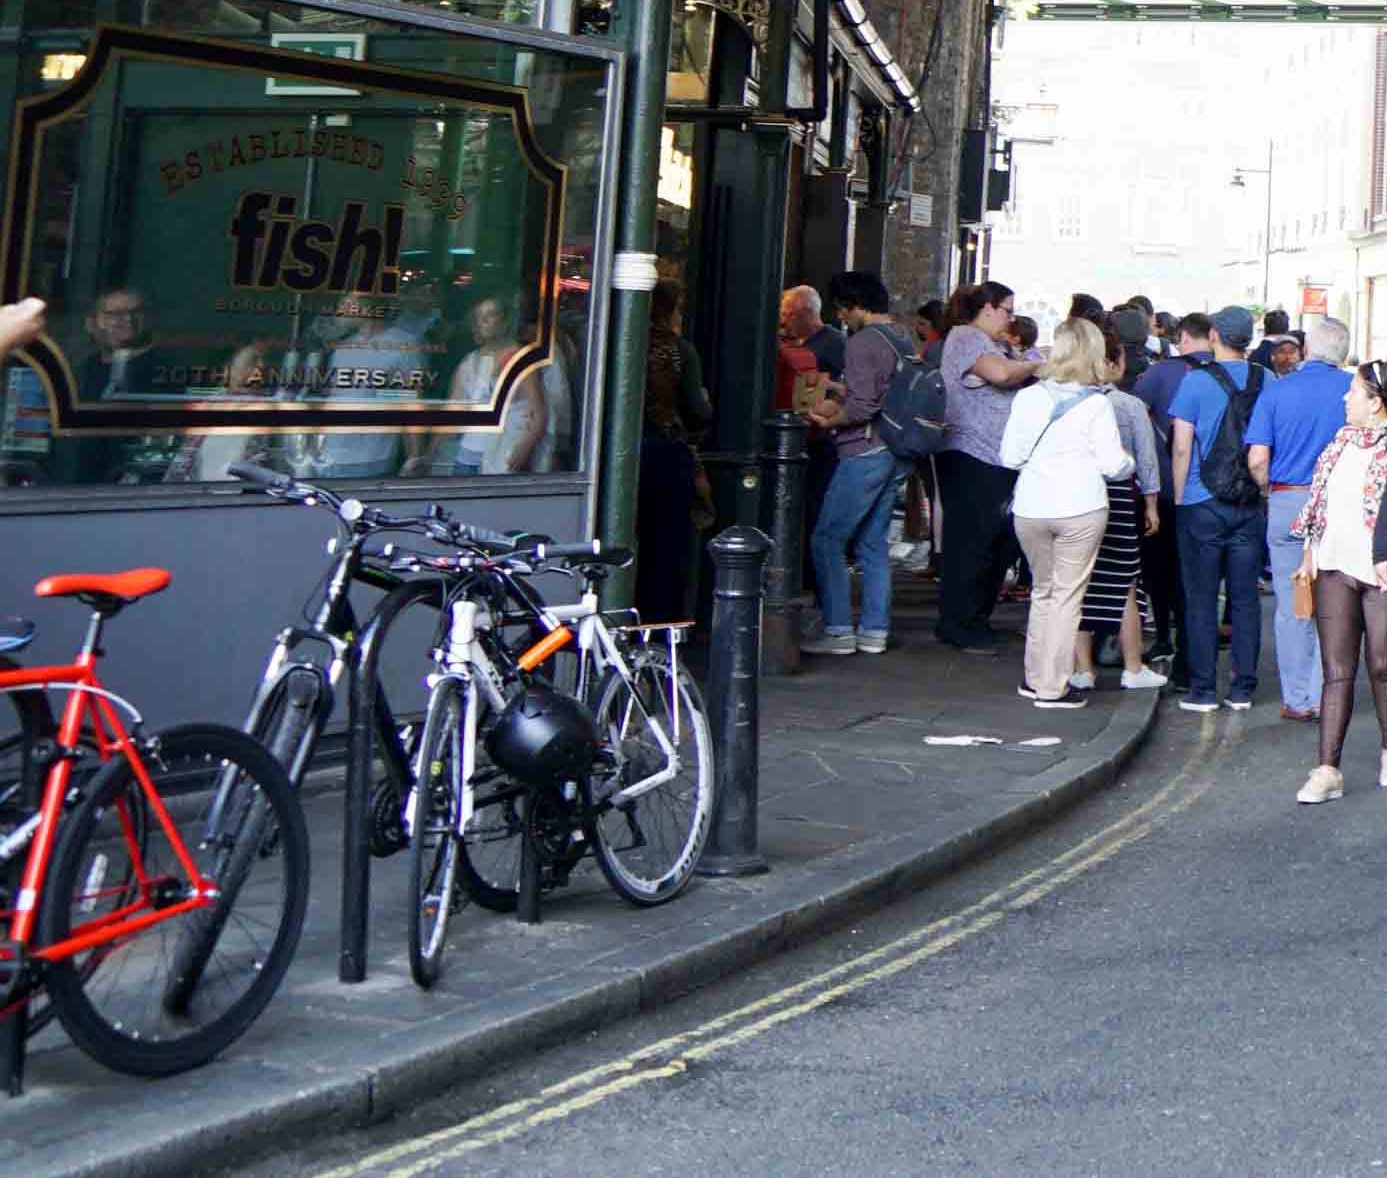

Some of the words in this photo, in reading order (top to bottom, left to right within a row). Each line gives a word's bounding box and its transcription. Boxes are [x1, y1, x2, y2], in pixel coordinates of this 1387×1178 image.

[231, 190, 405, 296] fish!
[320, 304, 400, 319] MARKET
[246, 367, 440, 388] ANNIVERSARY
